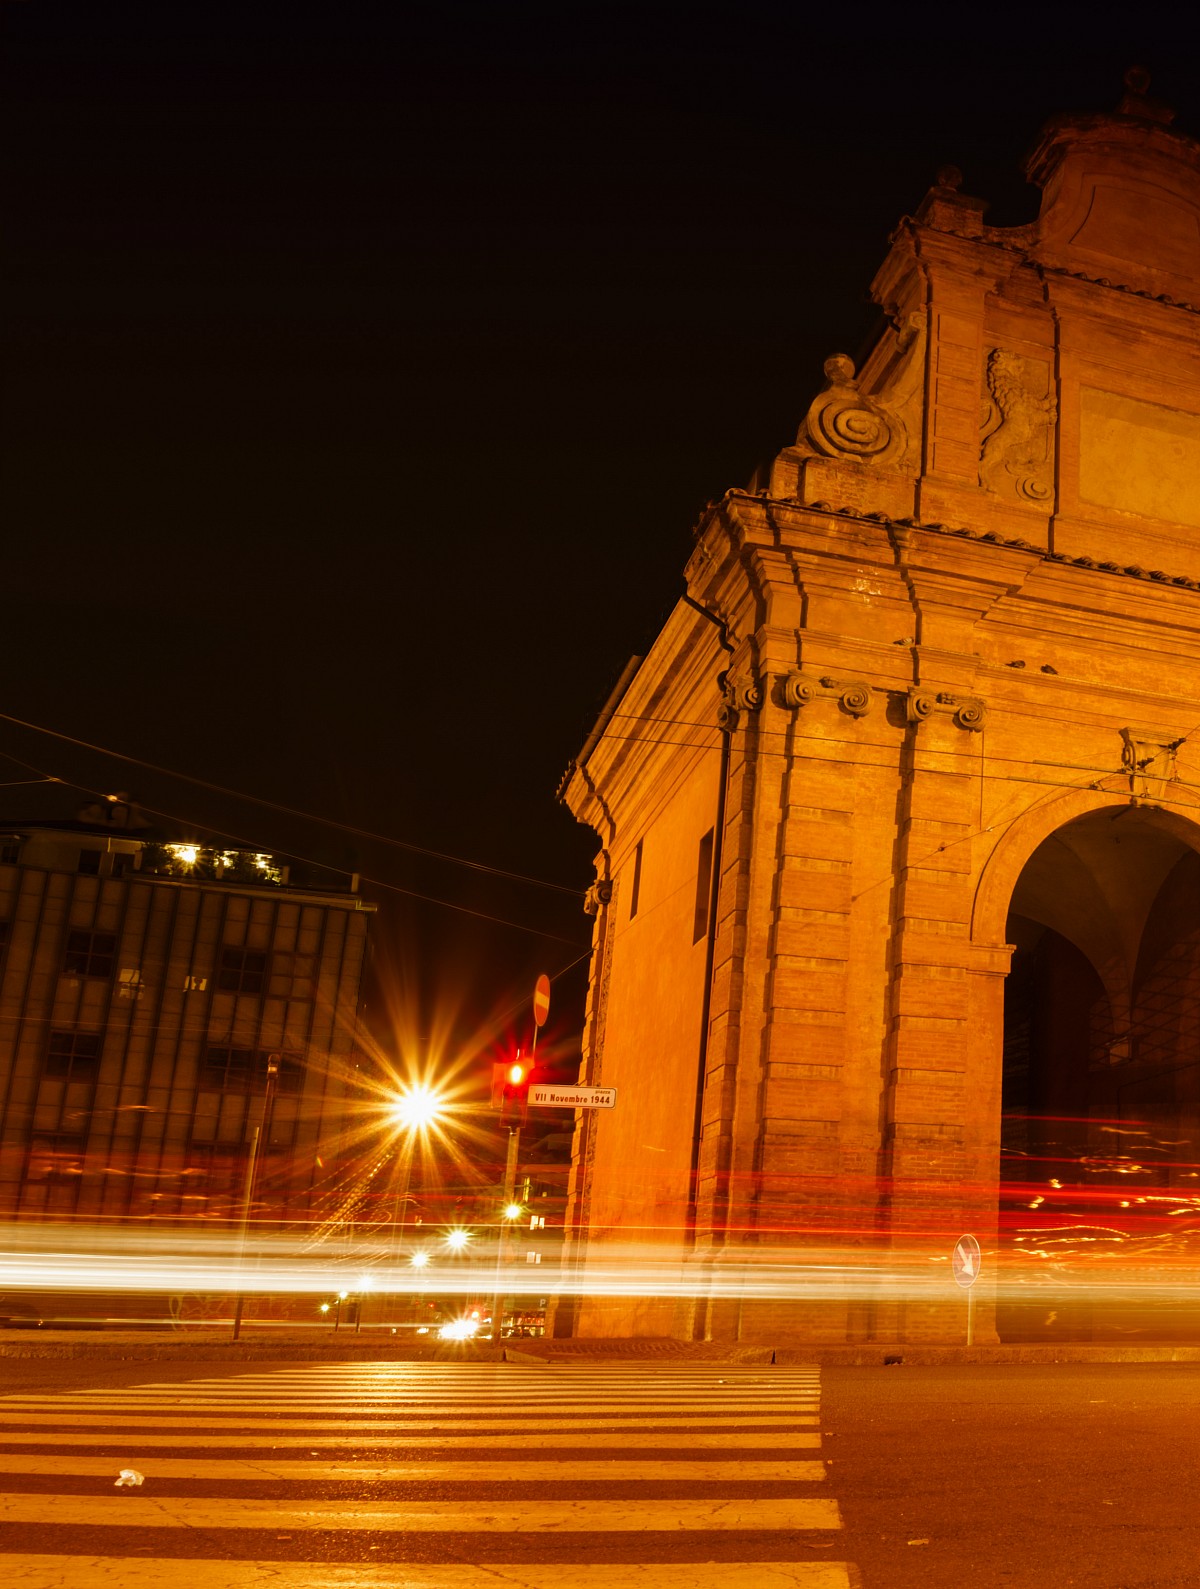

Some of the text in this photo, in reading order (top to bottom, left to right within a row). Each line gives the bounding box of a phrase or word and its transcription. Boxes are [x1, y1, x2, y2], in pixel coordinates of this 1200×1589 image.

[535, 1093, 610, 1104] VII Novembre 1944
[540, 1298, 546, 1307] P
